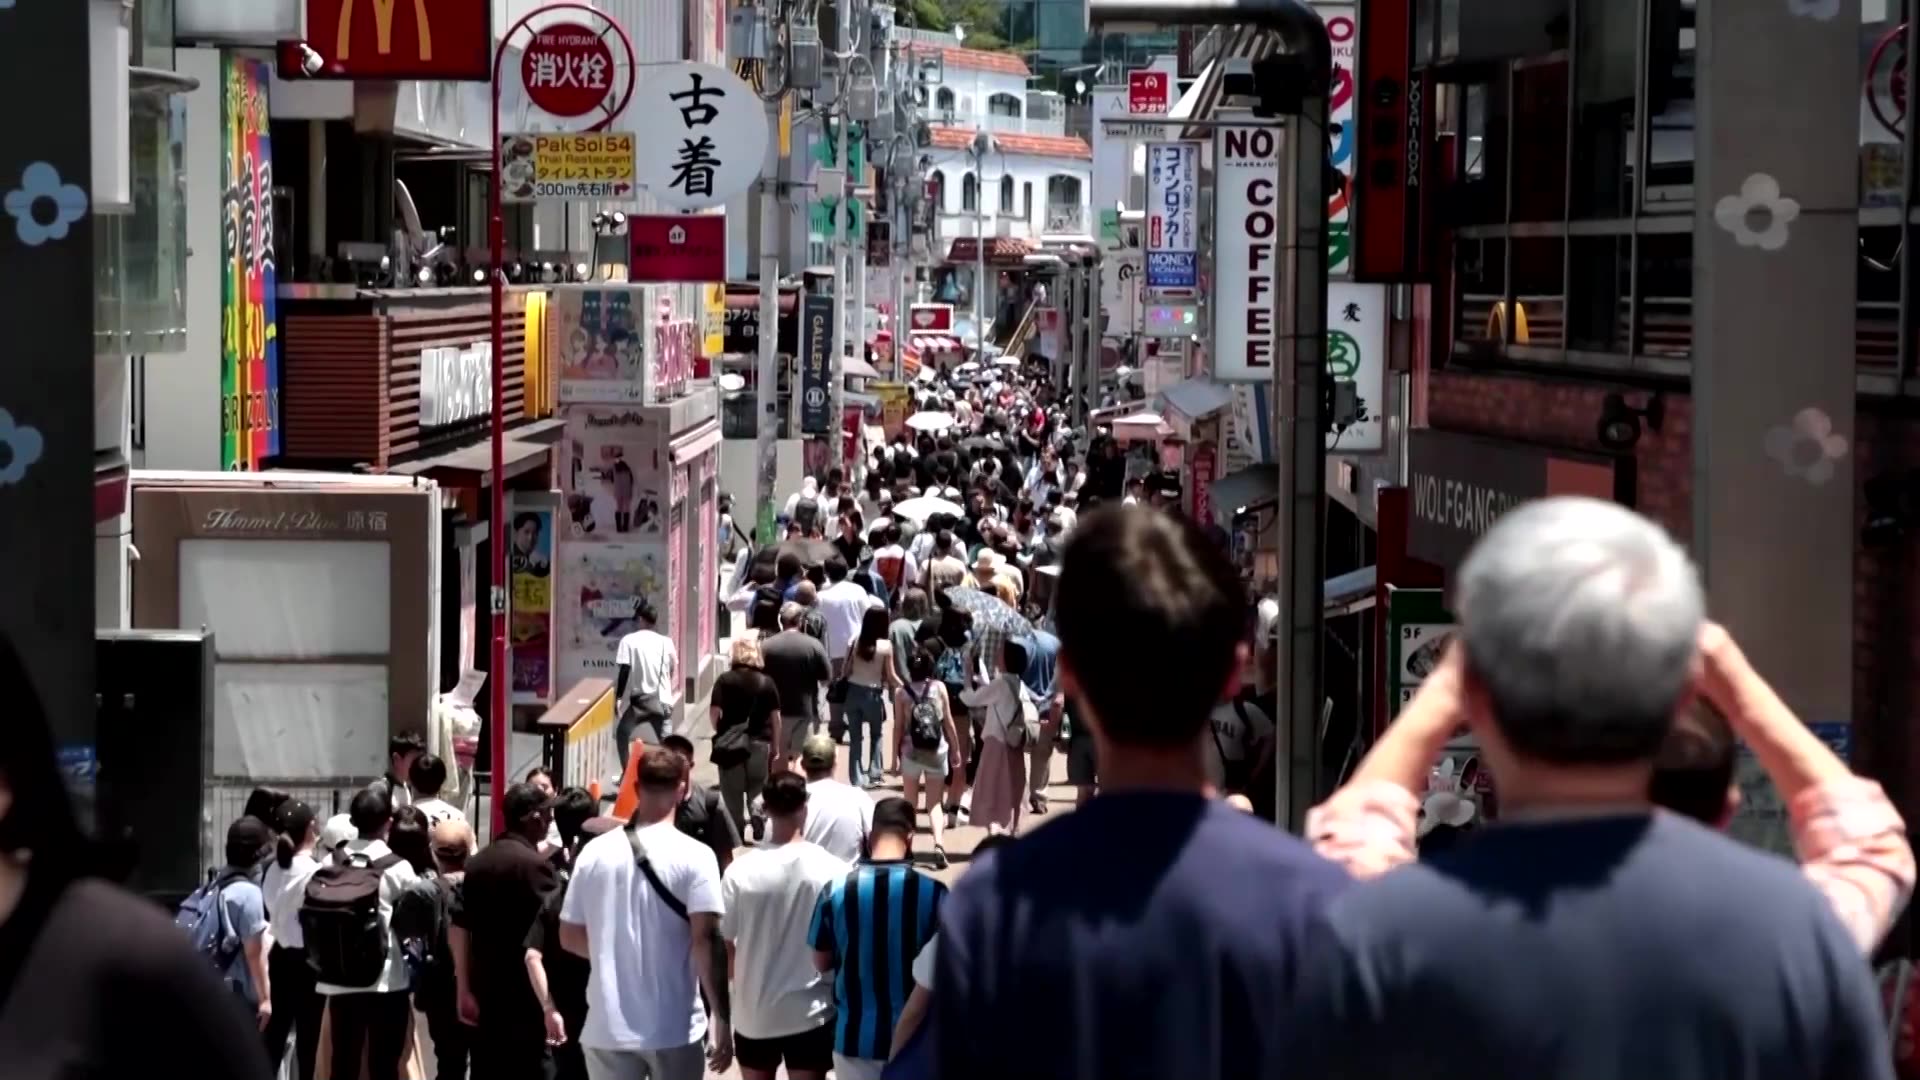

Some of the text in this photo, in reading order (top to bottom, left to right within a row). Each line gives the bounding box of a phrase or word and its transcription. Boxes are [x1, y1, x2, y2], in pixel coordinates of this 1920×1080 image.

[536, 35, 599, 46] FIRE HYDRANT
[529, 52, 607, 89] 消火栓
[536, 137, 631, 152] Pak Soi 54
[669, 72, 726, 198] 古着
[1408, 80, 1421, 187] YOSHINOYA
[538, 166, 631, 180] タイレストラン
[565, 154, 631, 164] Restaurant
[536, 182, 613, 197] 300m先右折
[1165, 147, 1181, 248] コインロッカー
[1148, 253, 1195, 265] MONEY
[1245, 178, 1275, 367] COFFEE
[811, 314, 825, 381] GALLERY
[222, 387, 279, 433] GRIZZLY
[347, 511, 389, 531] 原宿
[1413, 472, 1497, 536] WOLFGANG
